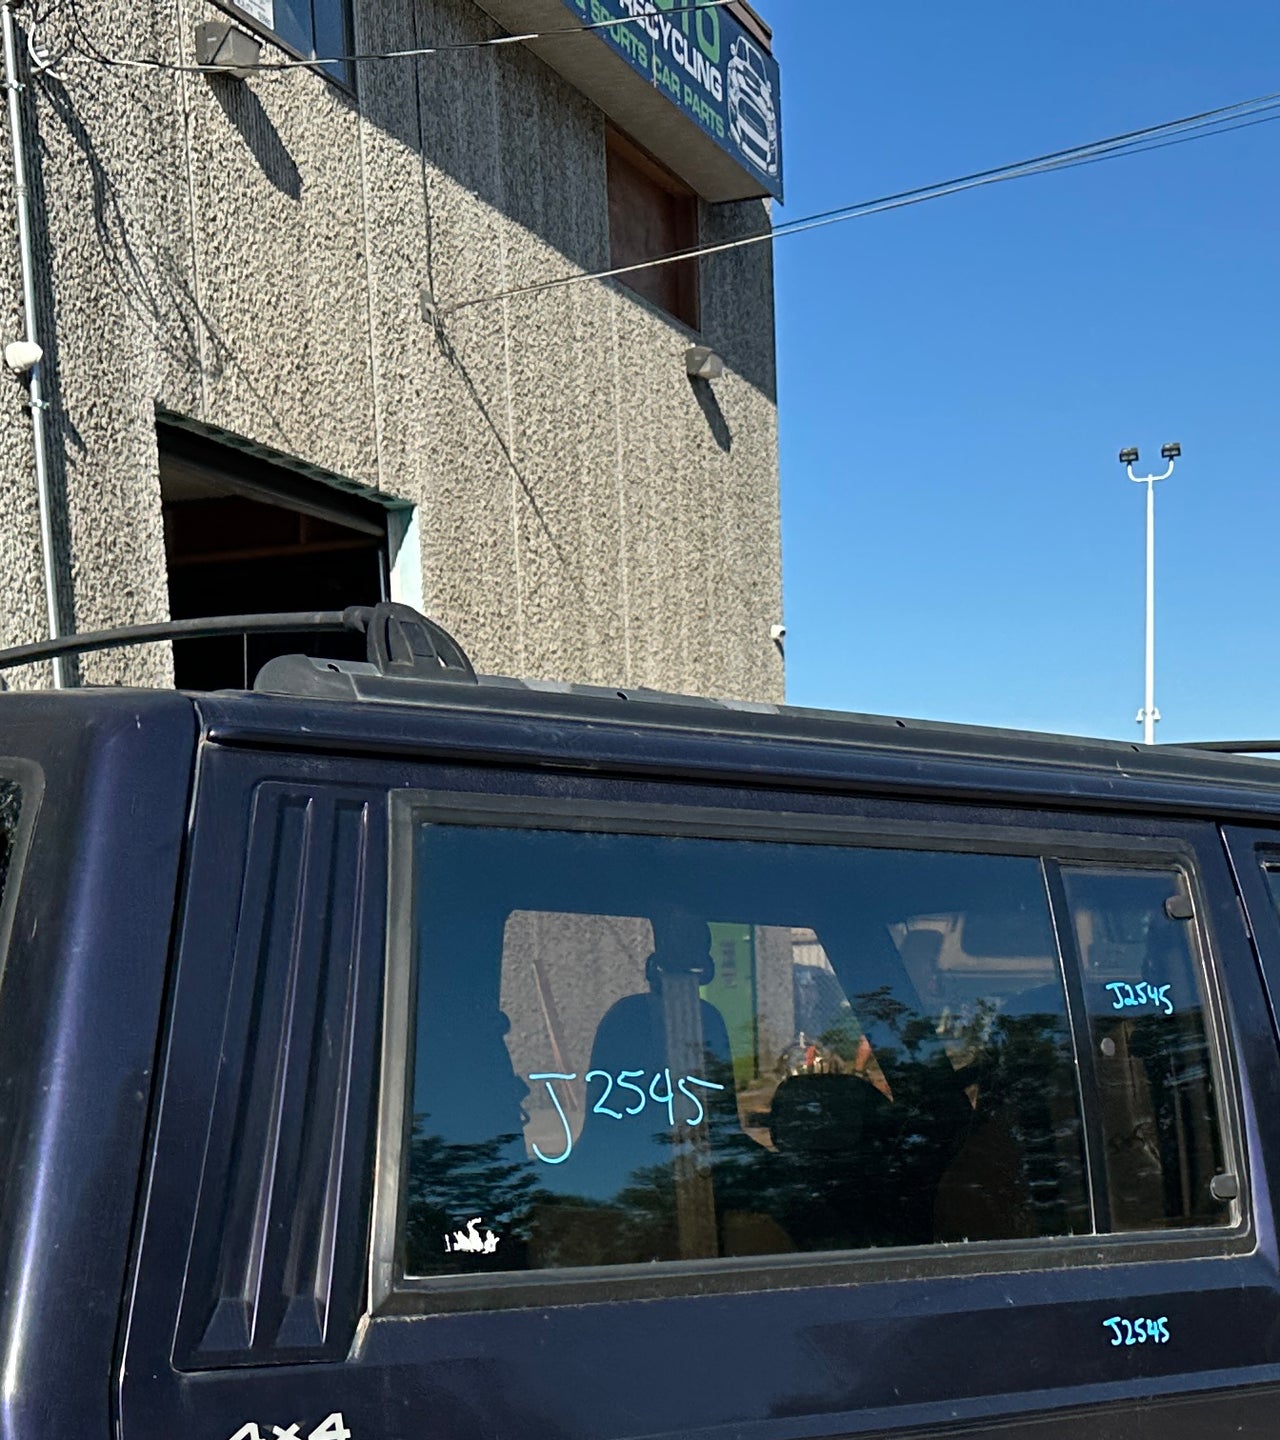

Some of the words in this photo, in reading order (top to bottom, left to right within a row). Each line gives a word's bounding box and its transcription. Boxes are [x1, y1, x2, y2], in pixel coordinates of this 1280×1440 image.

[590, 0, 648, 69] SPORTS
[653, 54, 681, 100] CAR
[683, 84, 725, 139] PARTS
[1105, 981, 1174, 1015] J2545
[529, 1068, 725, 1164] J2545
[1102, 1316, 1171, 1346] J2545
